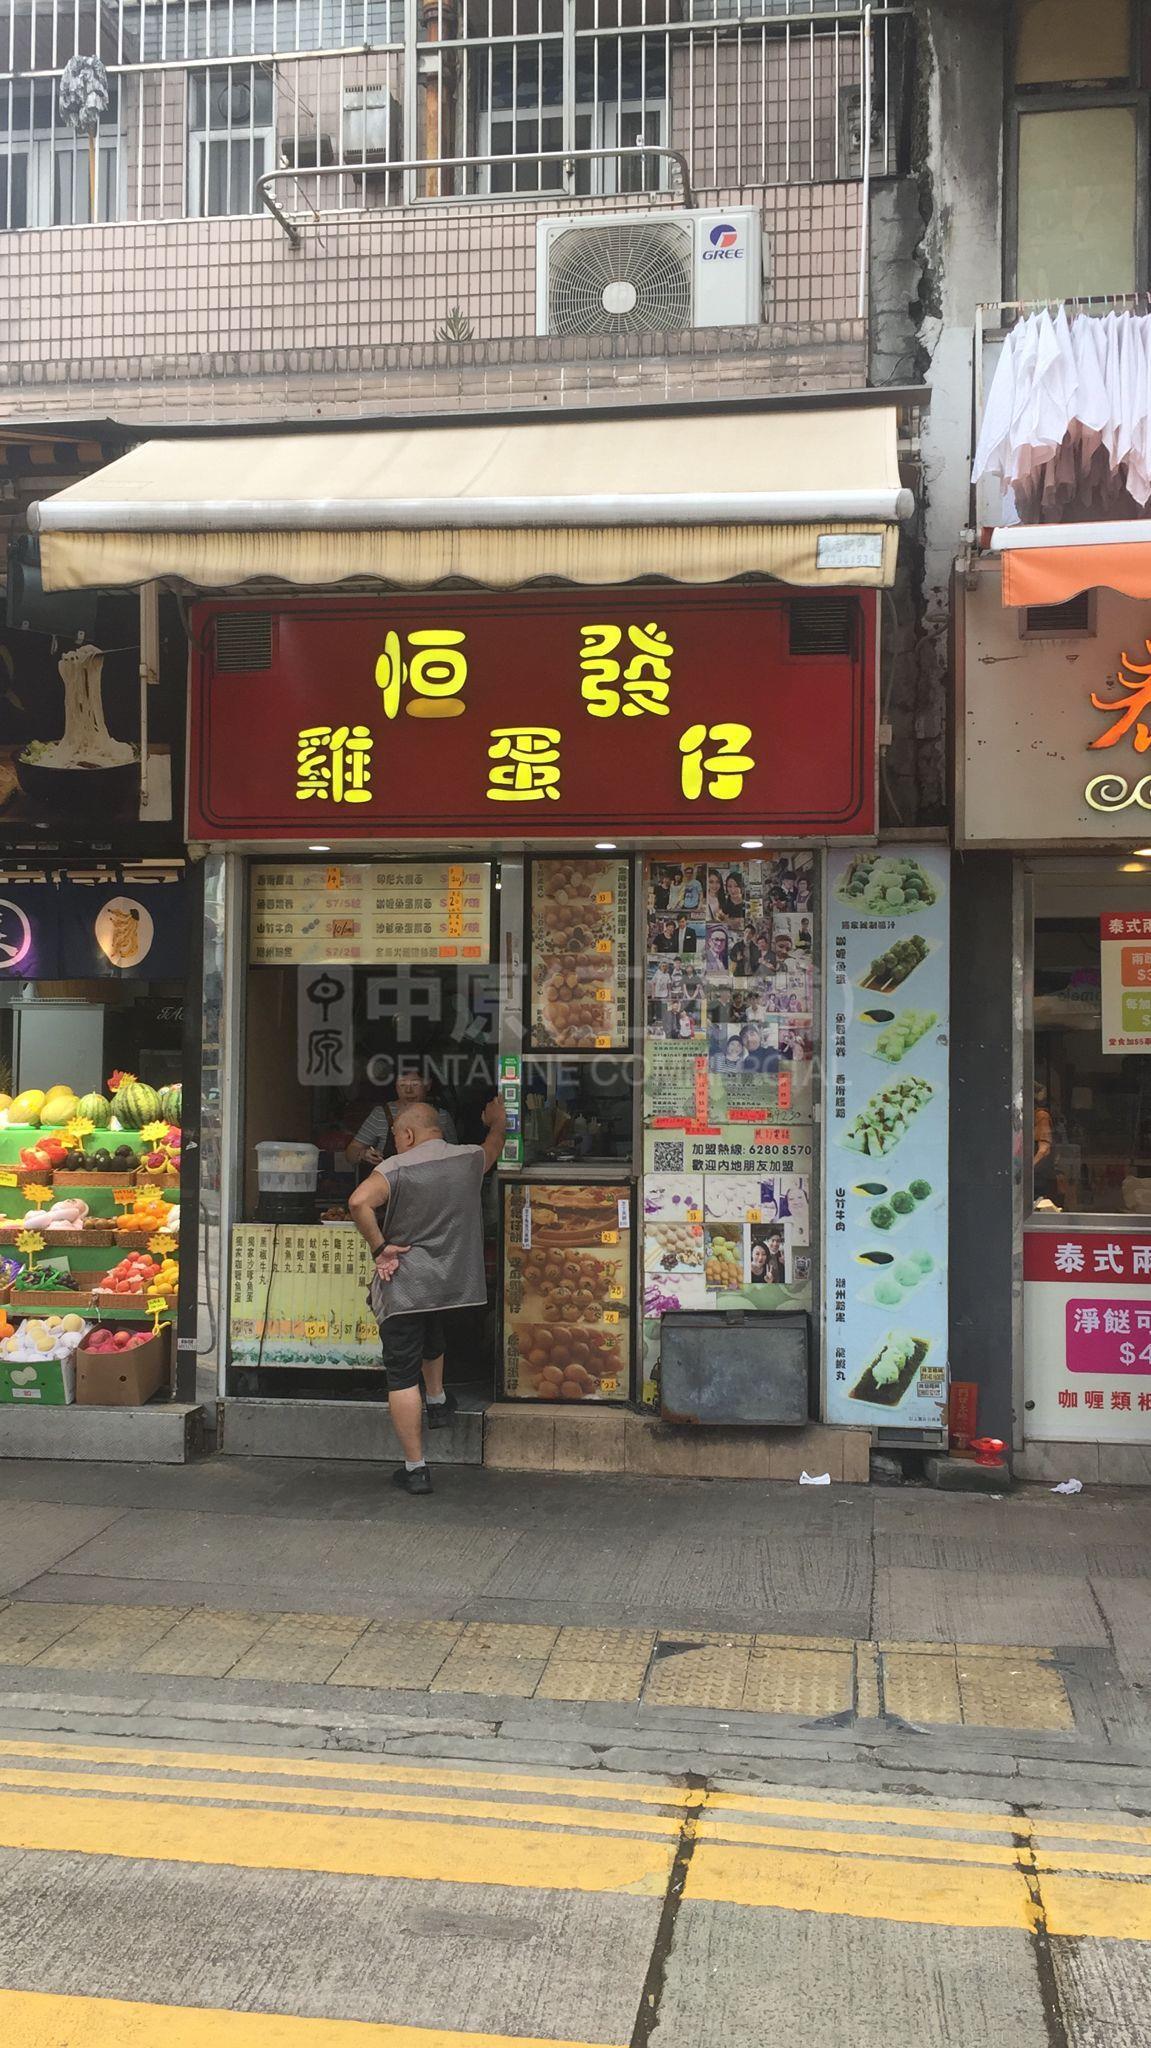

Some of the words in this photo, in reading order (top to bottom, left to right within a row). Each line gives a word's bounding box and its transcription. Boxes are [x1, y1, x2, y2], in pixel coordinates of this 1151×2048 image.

[702, 248, 744, 261] GREE
[296, 723, 755, 803] 雞蛋仔
[692, 1143, 746, 1155] 加盟熱線:
[749, 1144, 779, 1155] 6280
[782, 1145, 812, 1156] 8570
[835, 1187, 846, 1232] 山竹牛肉
[1119, 1341, 1151, 1366] $4
